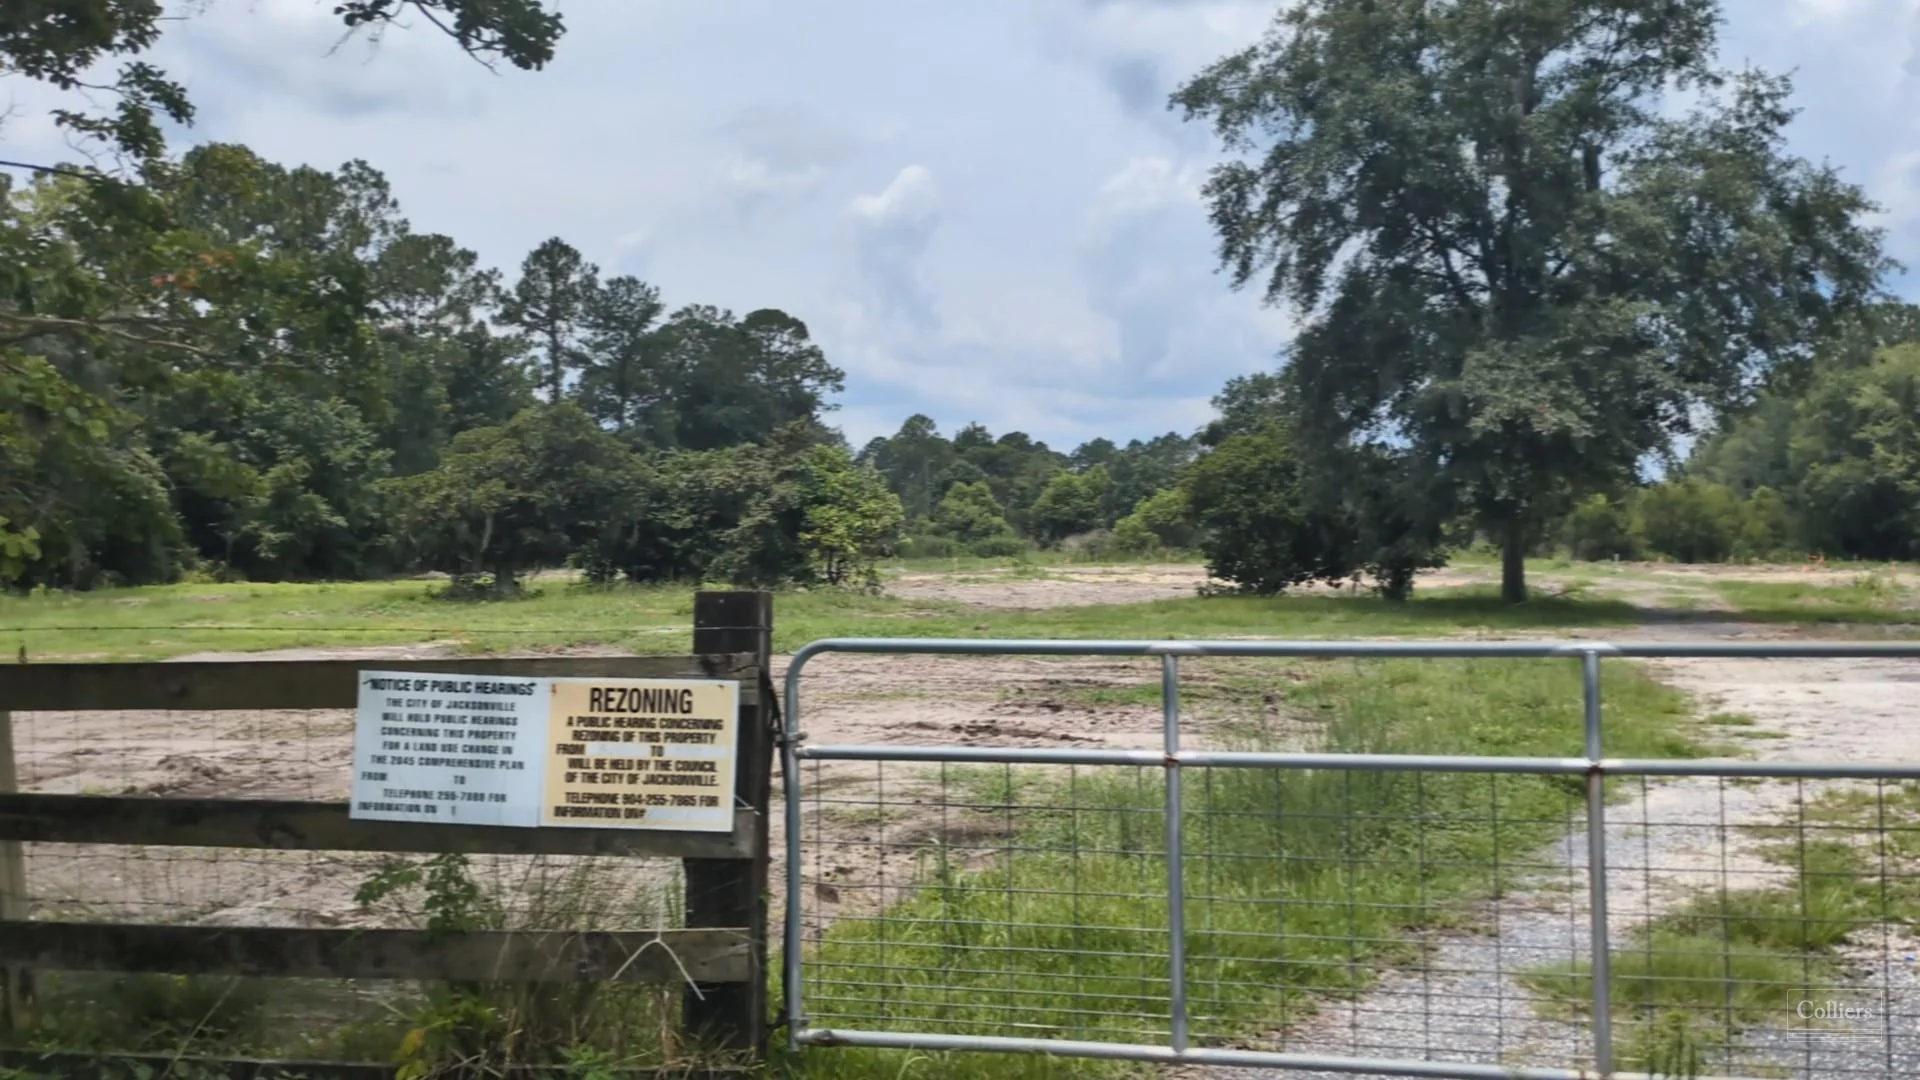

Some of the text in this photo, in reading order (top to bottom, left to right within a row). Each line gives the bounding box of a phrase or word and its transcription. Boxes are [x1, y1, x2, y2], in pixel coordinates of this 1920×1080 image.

[370, 678, 534, 695] NOTICE OF PUBLIC HEARINGS
[386, 698, 516, 712] THE CITY OF JACKSONVILLE
[589, 688, 693, 713] REZONING
[382, 713, 403, 722] WILL
[434, 714, 468, 724] PUBLIC
[470, 716, 518, 726] HEARINGS
[567, 717, 724, 730] A PUBLIC HEARING CONCERNING
[381, 727, 516, 740] CONCERNING THIS PROPERTY
[572, 730, 716, 744] REZONING OF THIS PROPERTY
[382, 741, 400, 750] FOR
[404, 742, 410, 751] A
[413, 742, 437, 752] LAND
[462, 744, 499, 755] CHANGE
[502, 746, 513, 755] IN
[556, 744, 664, 757] FROM TO
[371, 755, 387, 764] THE
[498, 760, 524, 770] PLAN
[568, 758, 717, 772] WILL BE HELD BY THE COUNCIL
[361, 771, 388, 781] FROM
[565, 772, 577, 783] OF
[581, 772, 598, 783] THE
[601, 773, 624, 784] CITY
[627, 774, 640, 784] OF
[383, 788, 434, 799] TELEPHONE
[488, 793, 507, 802] FOR
[565, 792, 620, 803] TELEPHONE
[700, 796, 719, 806] FOR
[358, 802, 421, 813] INFORMATION
[554, 806, 621, 818] INFORMATION
